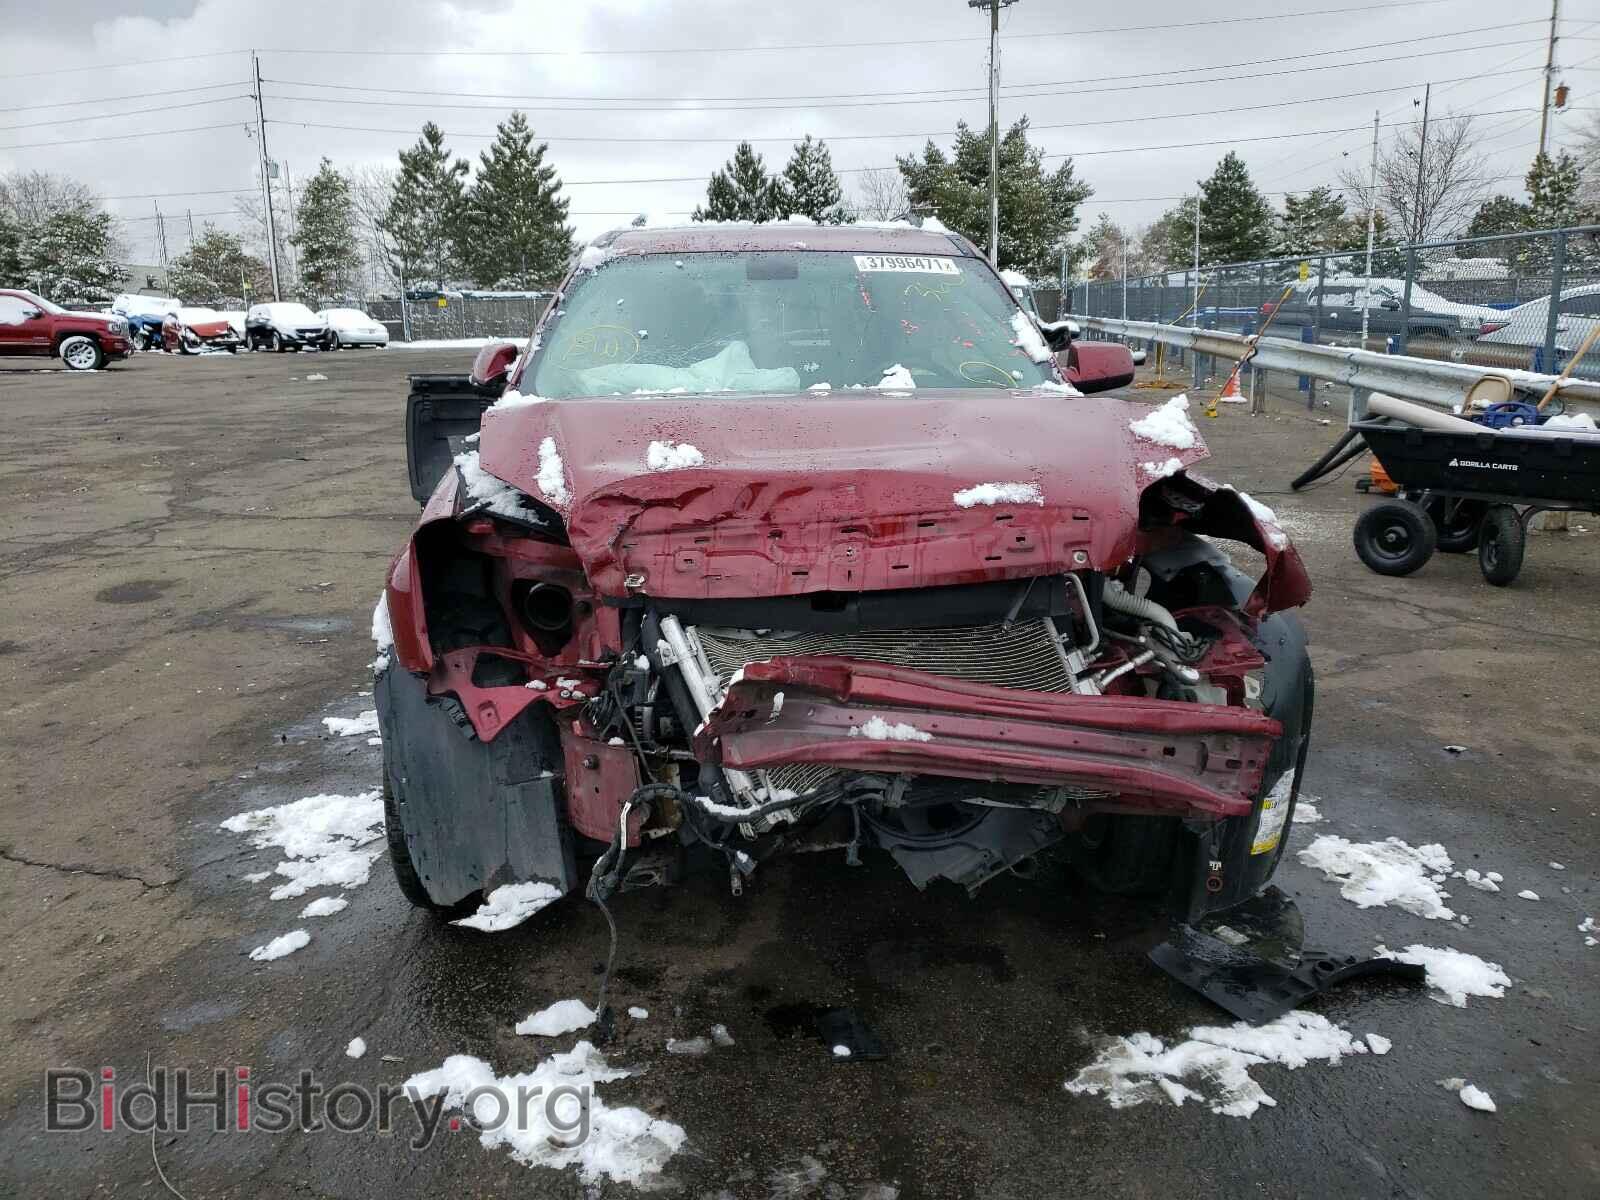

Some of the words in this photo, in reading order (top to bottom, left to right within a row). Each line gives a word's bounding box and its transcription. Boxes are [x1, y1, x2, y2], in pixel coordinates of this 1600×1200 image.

[867, 256, 943, 270] 37996471
[1459, 460, 1491, 469] GORILLA
[1492, 463, 1519, 471] CARTS
